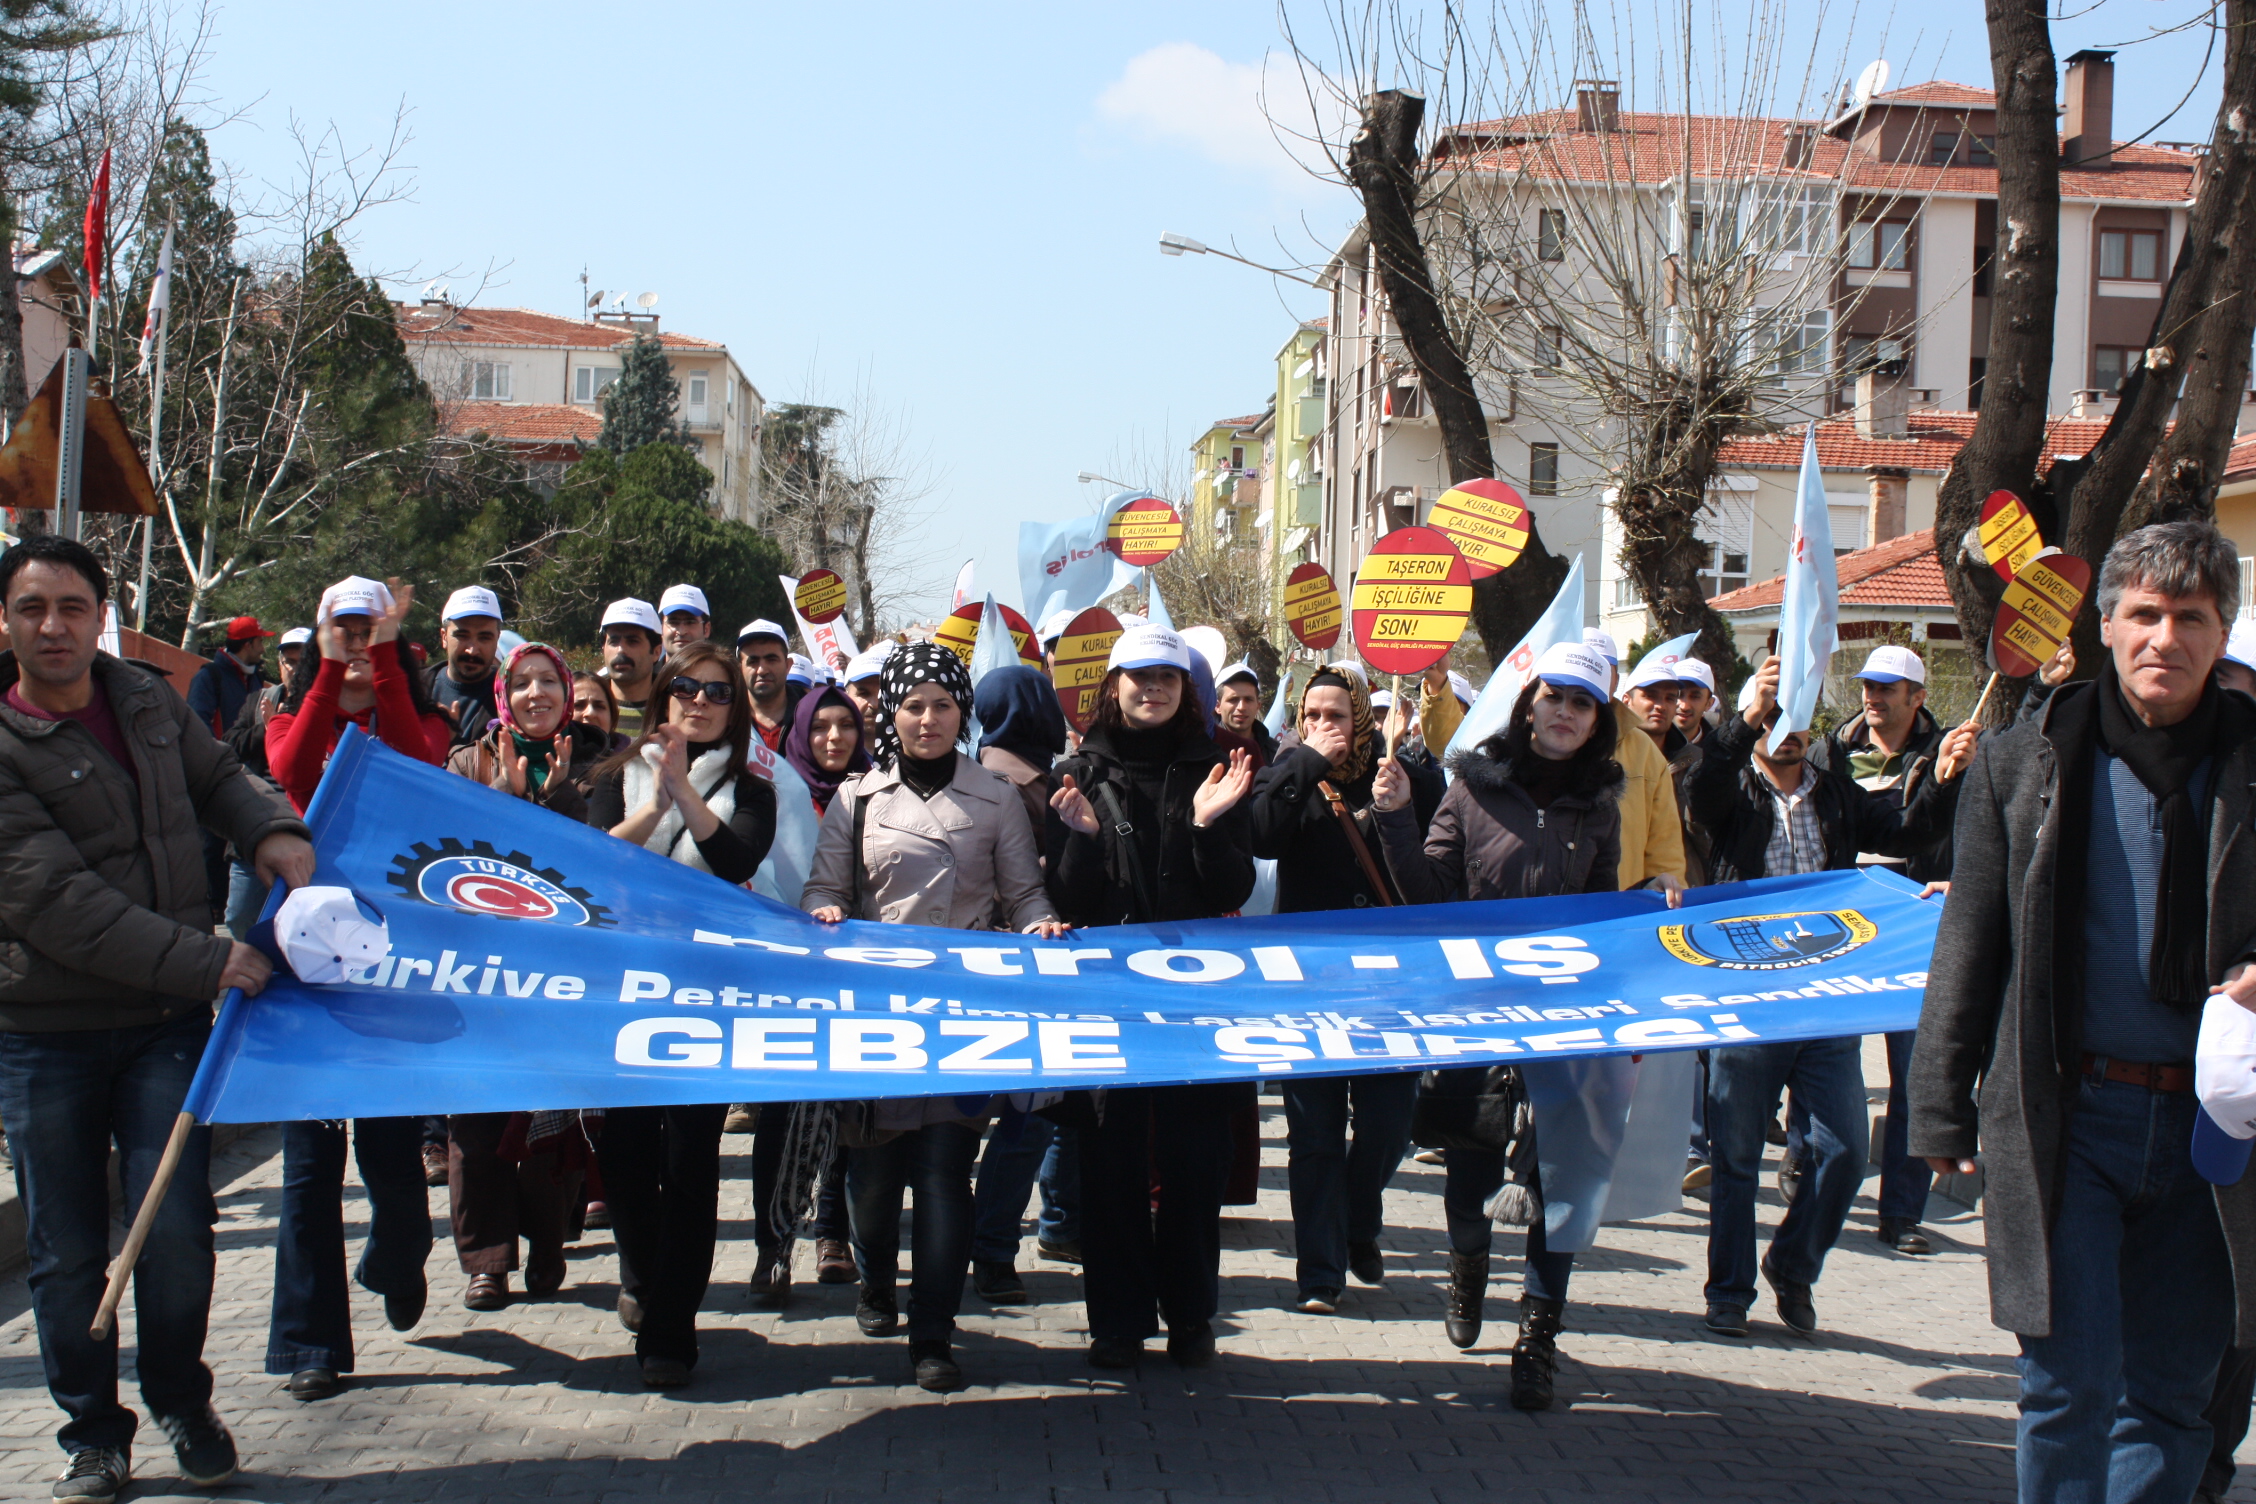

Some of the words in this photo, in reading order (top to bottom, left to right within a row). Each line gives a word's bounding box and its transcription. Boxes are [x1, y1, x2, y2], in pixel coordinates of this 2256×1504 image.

[1118, 511, 1169, 522] GÜVENCESİZ
[1464, 498, 1517, 520] KURALSIZ
[1122, 526, 1167, 536] ÇALIŞMAYA
[1448, 516, 1507, 539] ÇALIŞMAYA
[1124, 540, 1158, 550] HAYIR!
[1449, 537, 1488, 556] AYIR!
[2010, 548, 2029, 570] SON!
[1386, 560, 1447, 578] TAŞERON
[798, 576, 833, 594] GÜVENCESİZ
[1300, 578, 1328, 595] KURALSIZ
[2032, 568, 2080, 608] GÜVENCESİZ
[805, 588, 836, 605] ÇALIŞMAYA
[1298, 596, 1332, 616] ÇALIŞMAYA
[1372, 586, 1446, 608] İŞÇİLİĞİNE
[810, 600, 834, 614] HAYIR!
[2019, 598, 2062, 630] ÇALIŞMAYA
[1305, 615, 1331, 632] HAYIR!
[1377, 619, 1419, 636] SON!
[1081, 635, 1120, 653] KURALS
[2009, 623, 2042, 651] HAYIR!
[1074, 664, 1108, 685] ÇALIŞ
[619, 969, 856, 1011] Petrol
[1143, 1011, 1376, 1030] Lastik
[615, 1016, 1127, 1071] GEBZE
